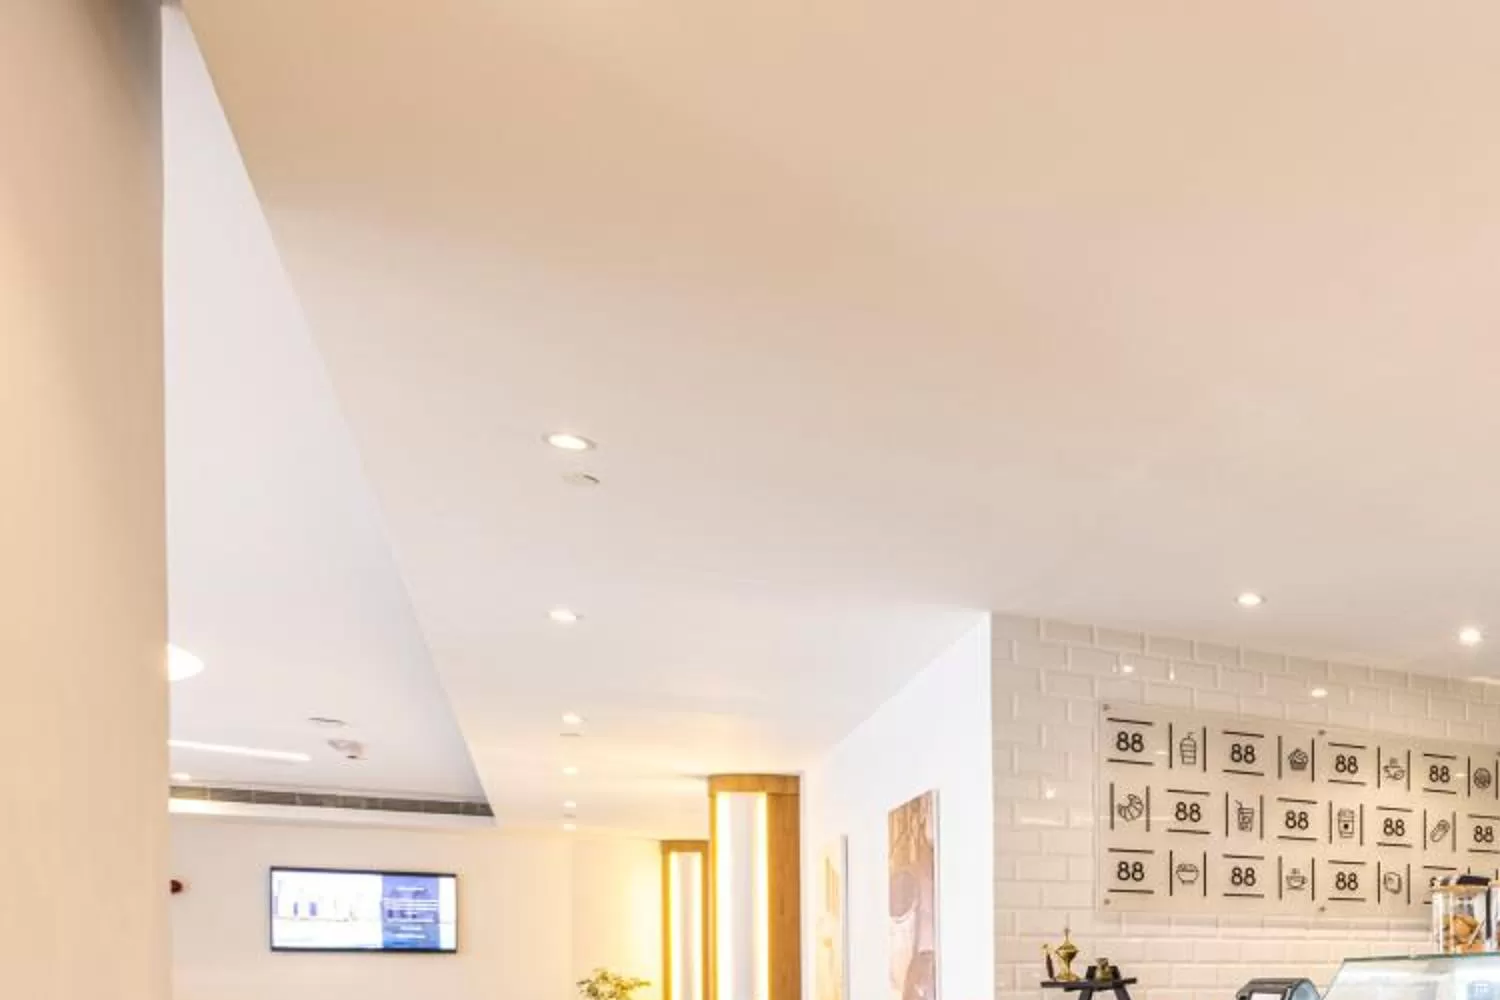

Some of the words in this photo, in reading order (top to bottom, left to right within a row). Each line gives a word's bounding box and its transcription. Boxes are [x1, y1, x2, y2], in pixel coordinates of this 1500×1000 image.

[1116, 732, 1144, 753] 88
[1231, 744, 1255, 764] 88
[1335, 755, 1358, 774] 88
[1429, 766, 1451, 783] 88
[1175, 803, 1201, 822] 88
[1285, 812, 1309, 829] 88
[1383, 819, 1405, 836] 88
[1474, 826, 1494, 843] 88
[1117, 862, 1145, 881] 88
[1232, 868, 1256, 886] 88
[1335, 873, 1358, 890] 88
